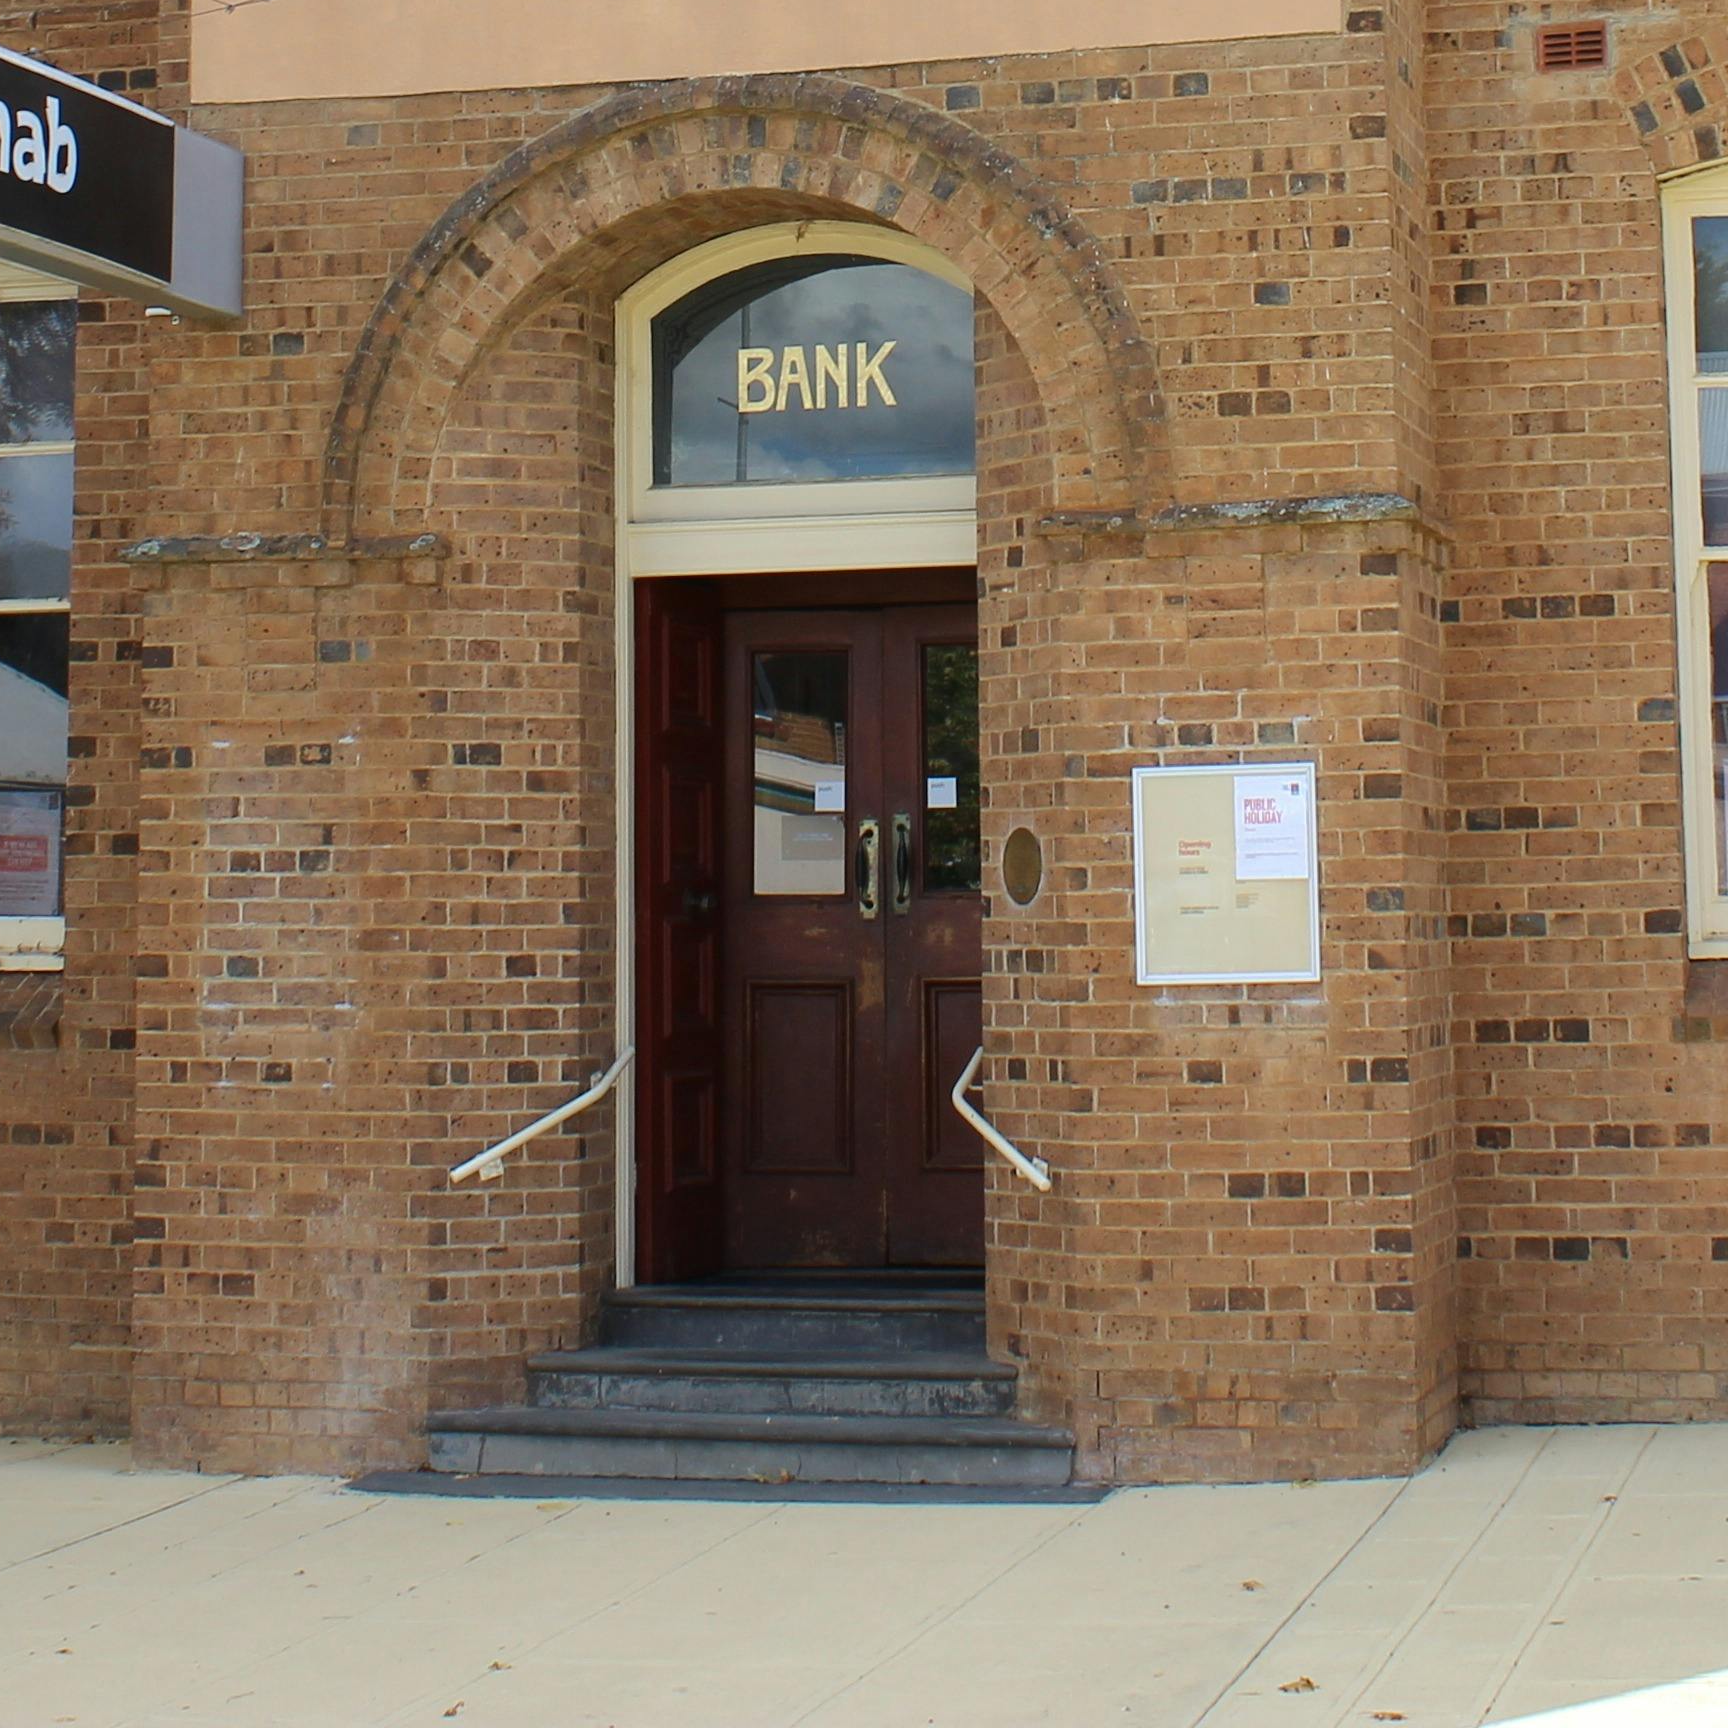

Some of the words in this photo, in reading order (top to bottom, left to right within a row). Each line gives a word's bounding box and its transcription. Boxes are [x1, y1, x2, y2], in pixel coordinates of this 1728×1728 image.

[737, 340, 898, 413] BANK
[1244, 798, 1276, 810] PUBLIC
[1244, 811, 1282, 824] HOLIDAY
